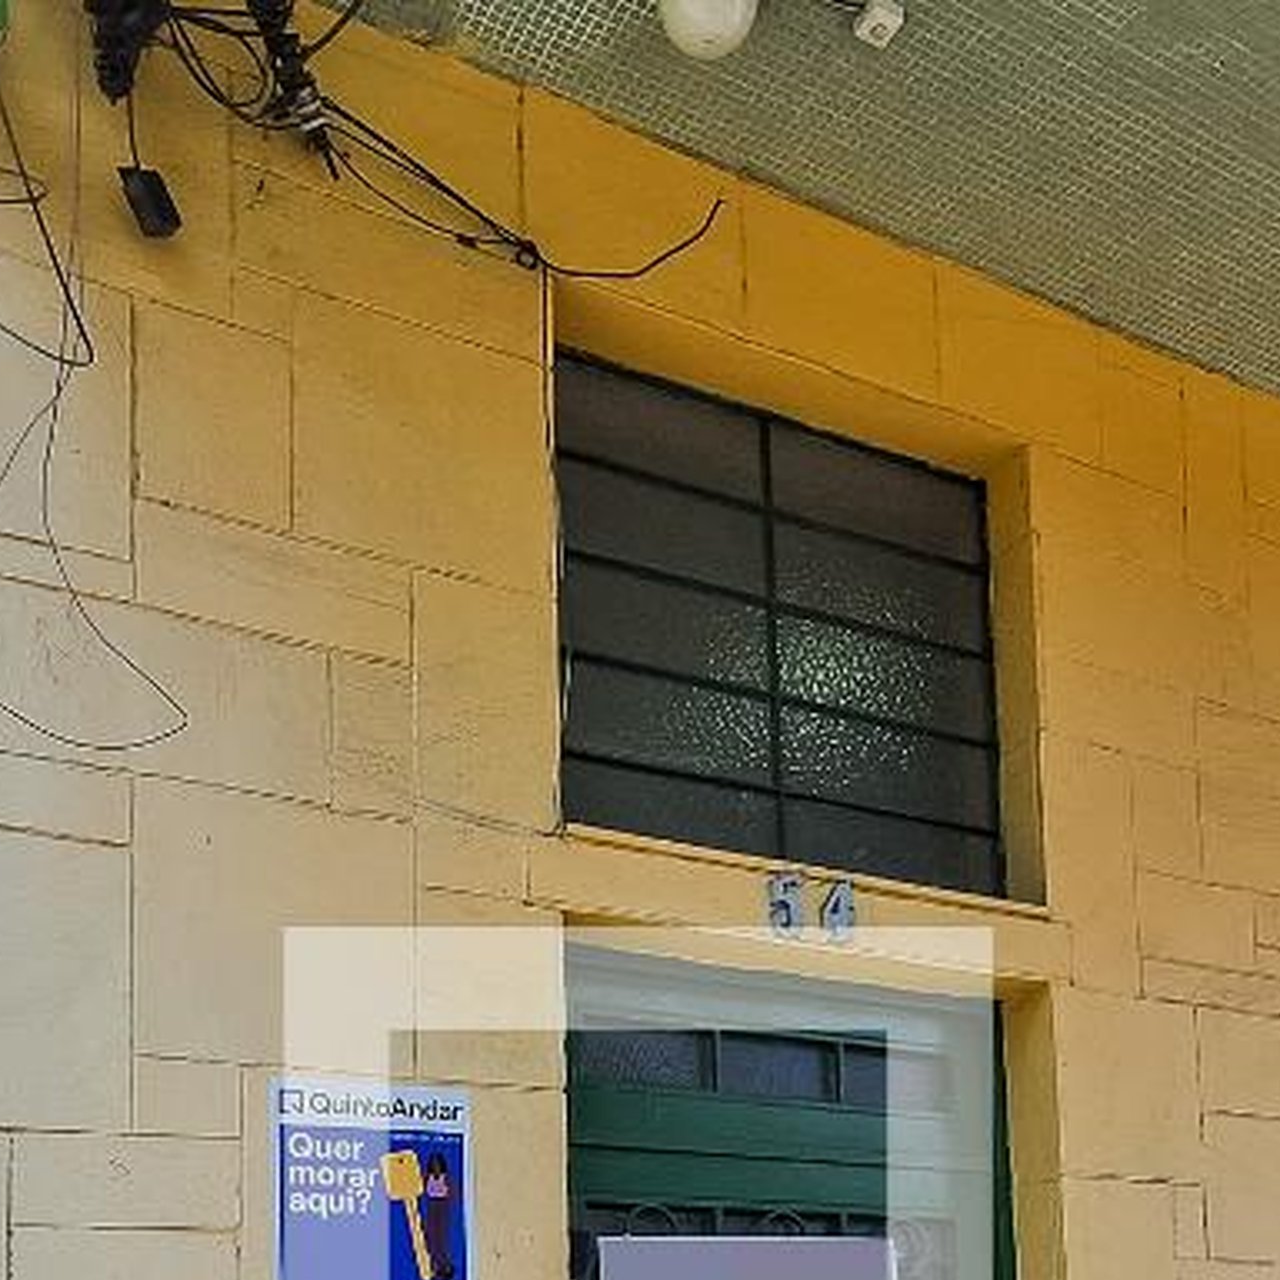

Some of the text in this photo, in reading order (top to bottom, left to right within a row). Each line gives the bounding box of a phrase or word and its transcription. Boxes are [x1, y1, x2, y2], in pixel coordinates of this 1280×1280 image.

[309, 1092, 465, 1121] QuintoAndar
[288, 1132, 365, 1160] Quer
[288, 1163, 379, 1188] morar
[288, 1189, 372, 1218] aqui?
